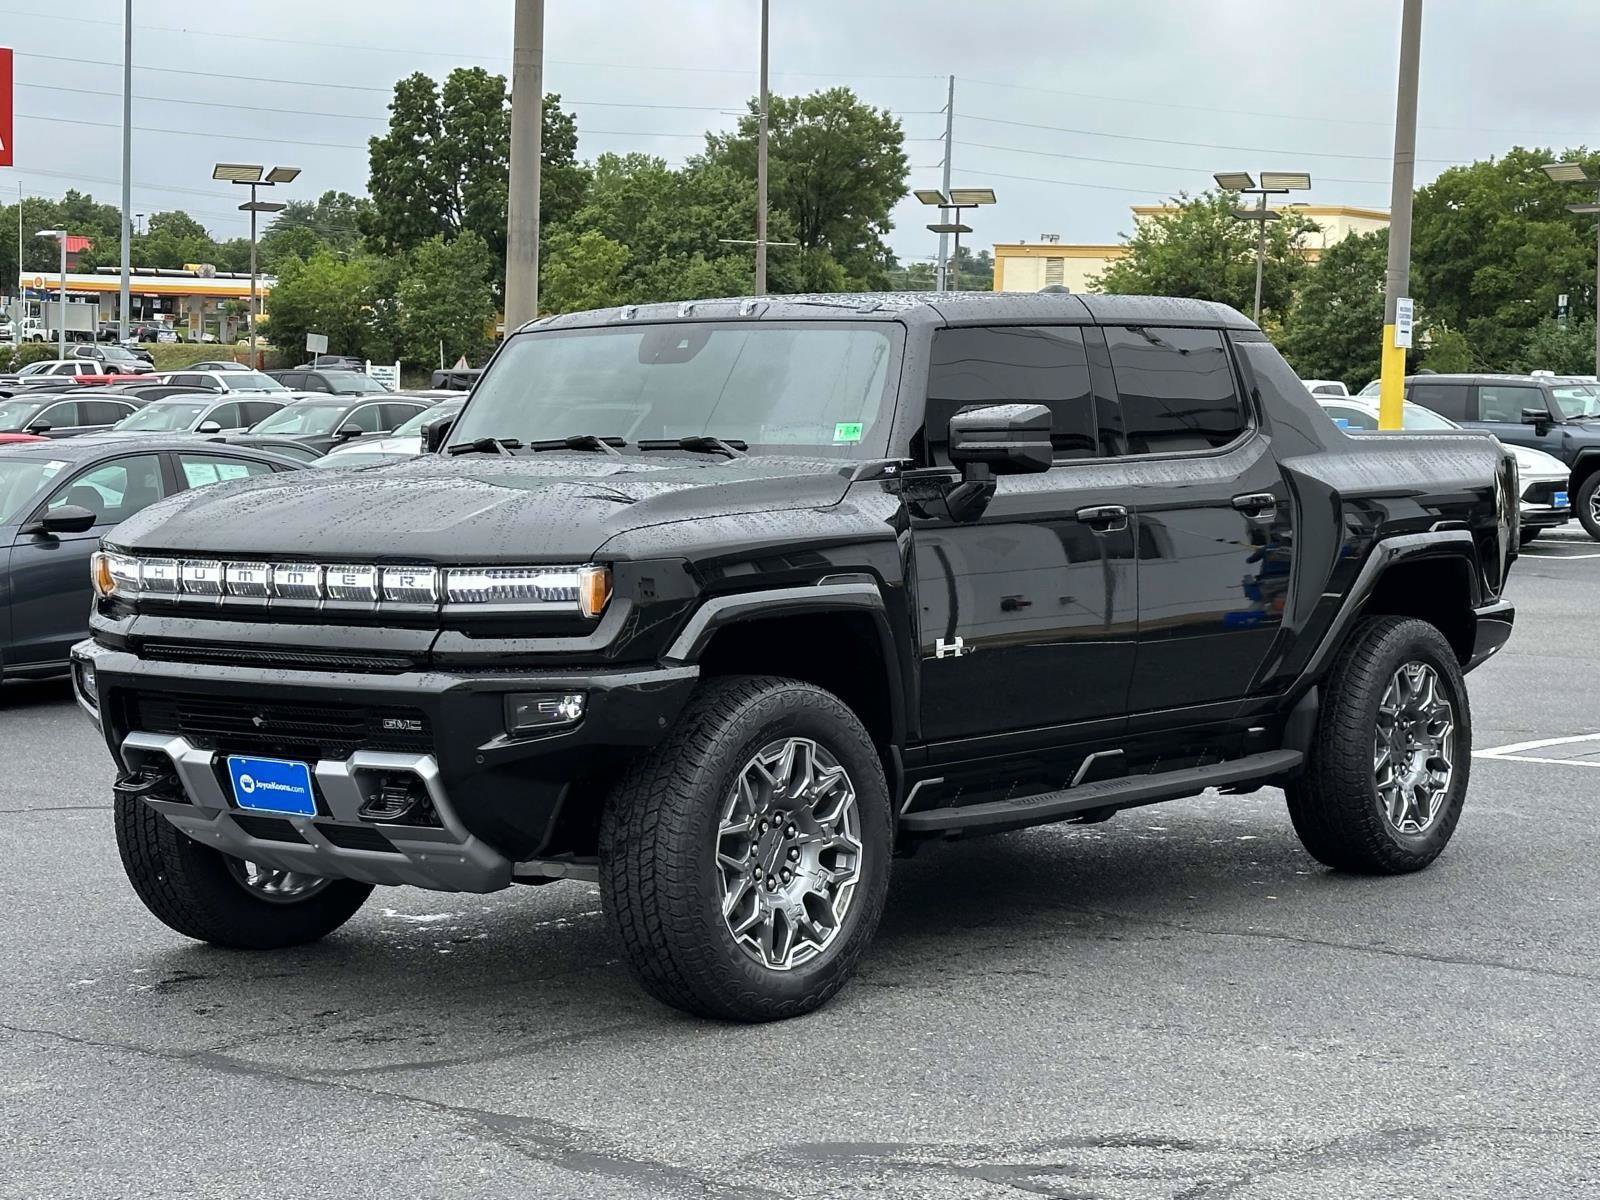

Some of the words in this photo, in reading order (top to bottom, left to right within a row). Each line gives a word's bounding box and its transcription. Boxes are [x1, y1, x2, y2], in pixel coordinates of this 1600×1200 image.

[154, 567, 416, 587] HUMMER
[383, 718, 422, 731] GMC
[255, 780, 305, 794] JoyceKoons.com
